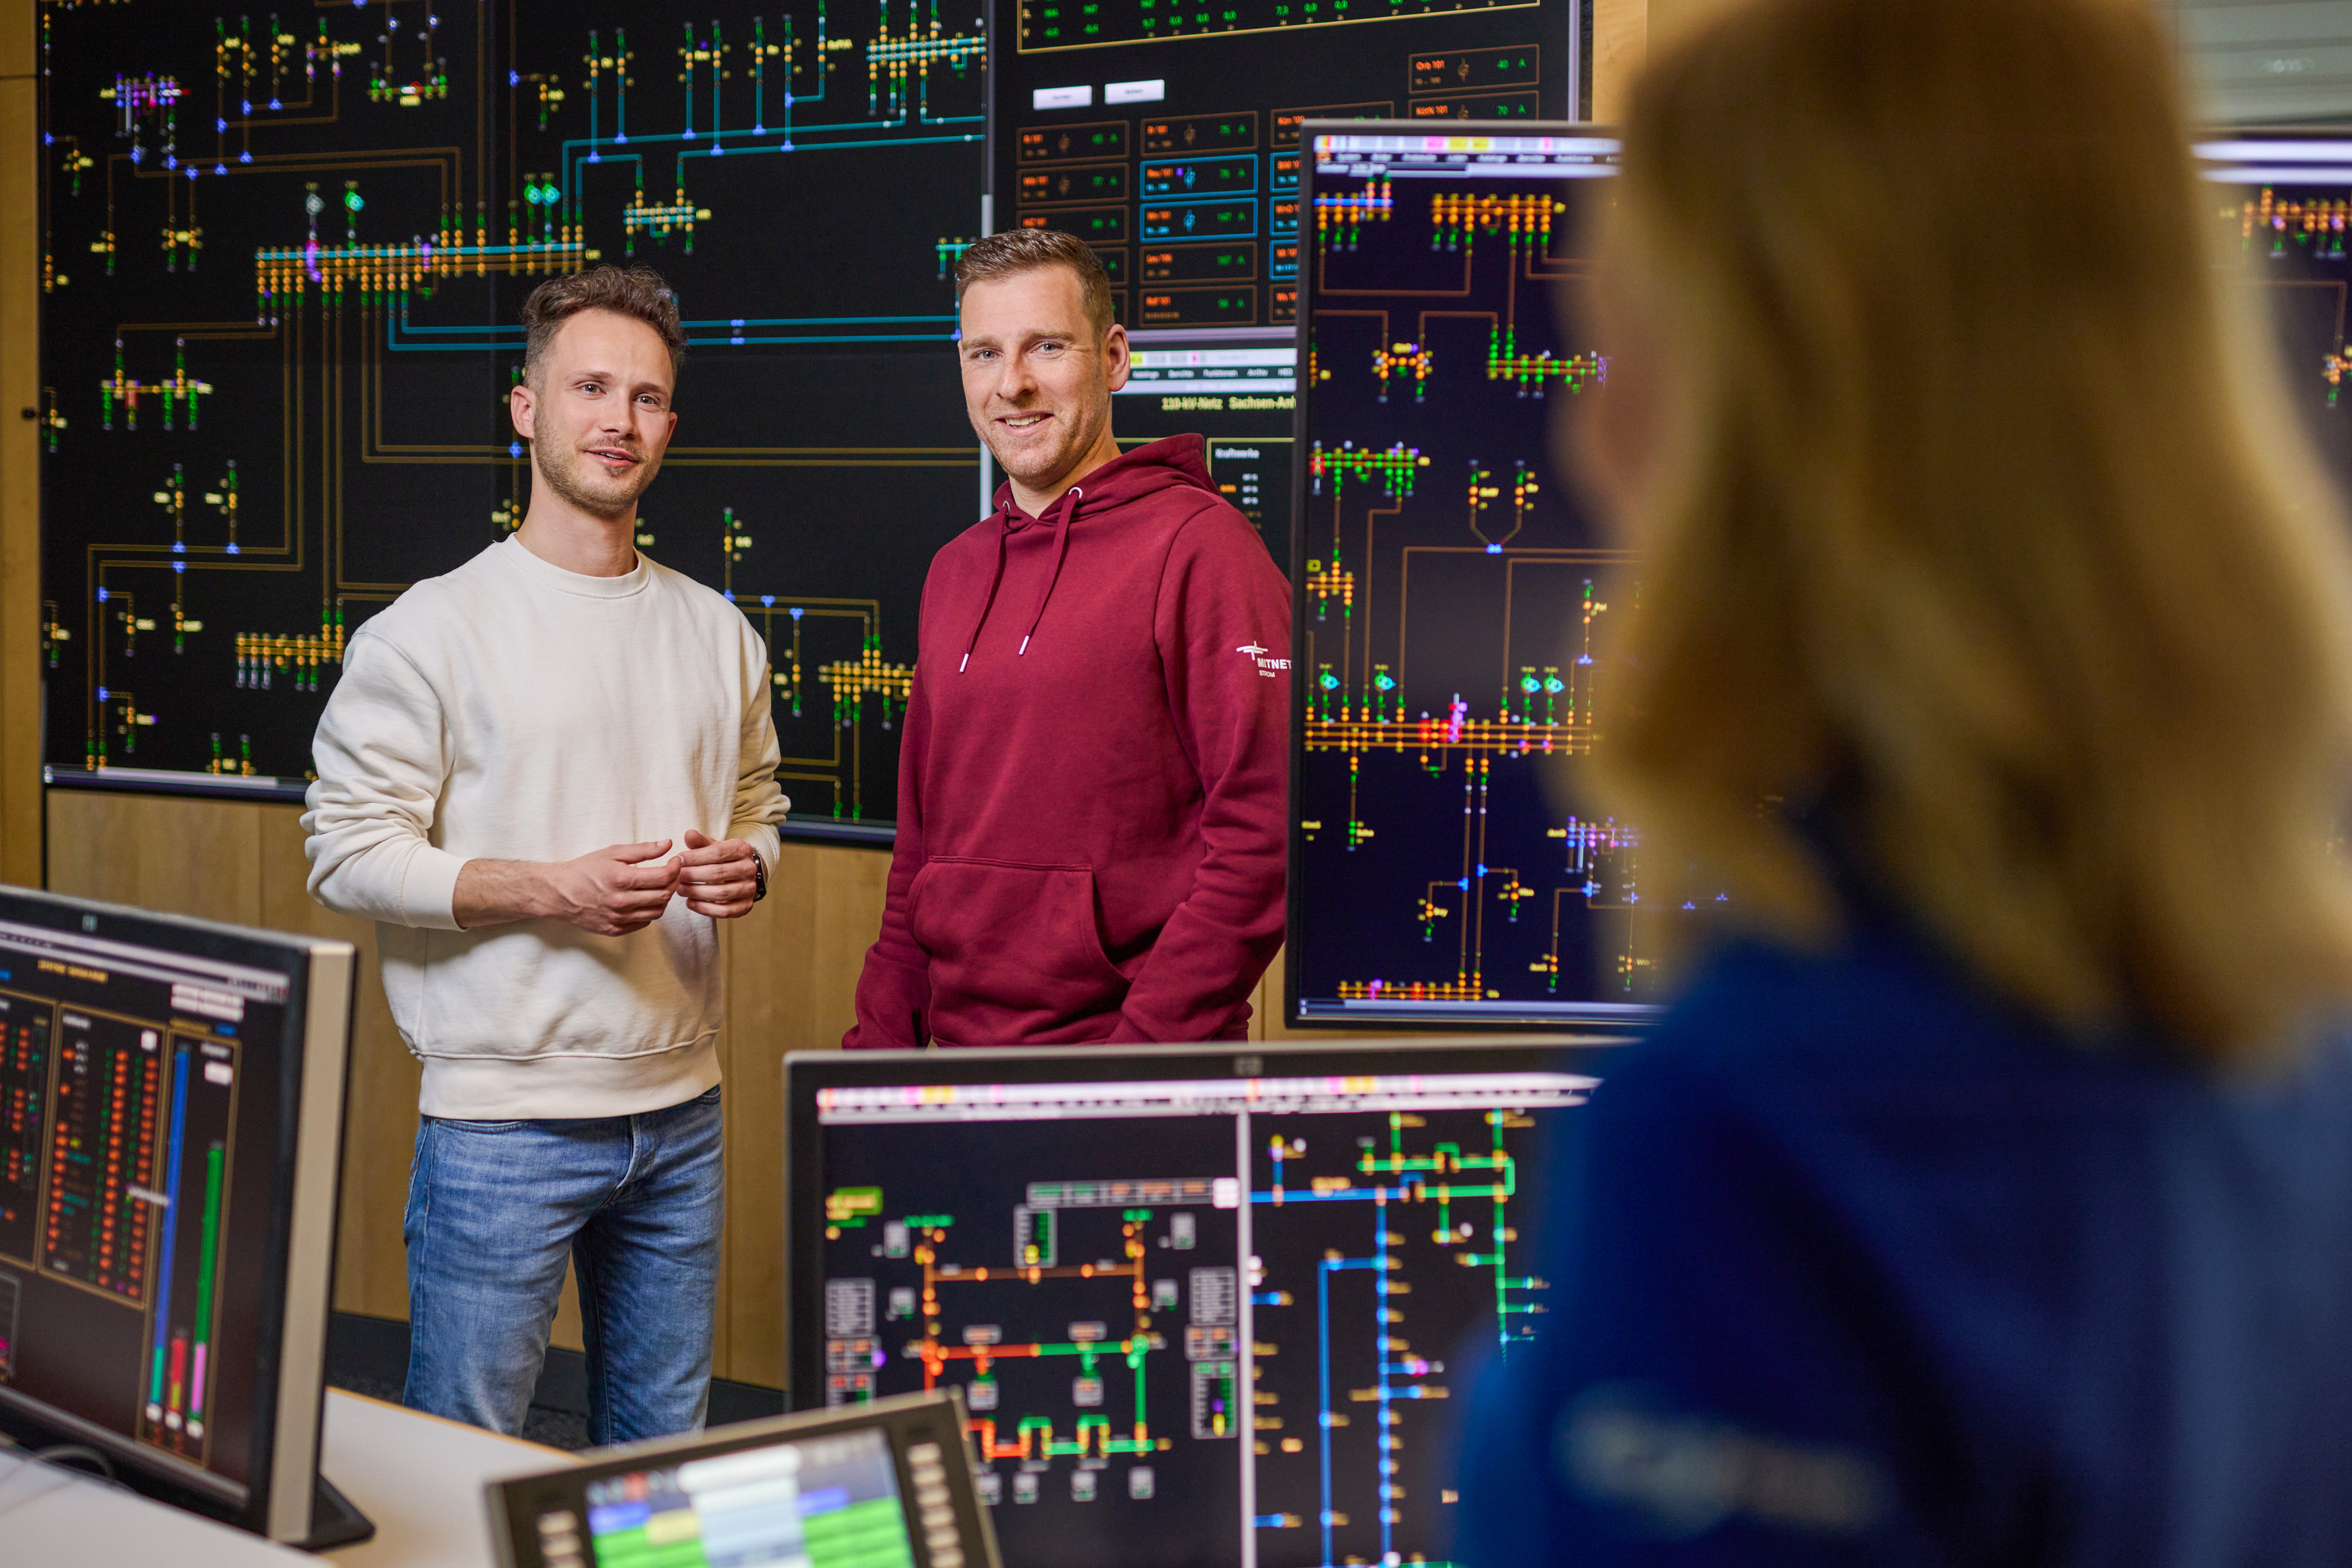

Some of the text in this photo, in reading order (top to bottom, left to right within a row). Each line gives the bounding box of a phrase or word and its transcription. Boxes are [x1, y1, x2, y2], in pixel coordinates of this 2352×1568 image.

[1518, 58, 1526, 67] A
[1518, 104, 1526, 114] A
[1257, 658, 1292, 669] MITNET
[1259, 670, 1275, 678] STROM
